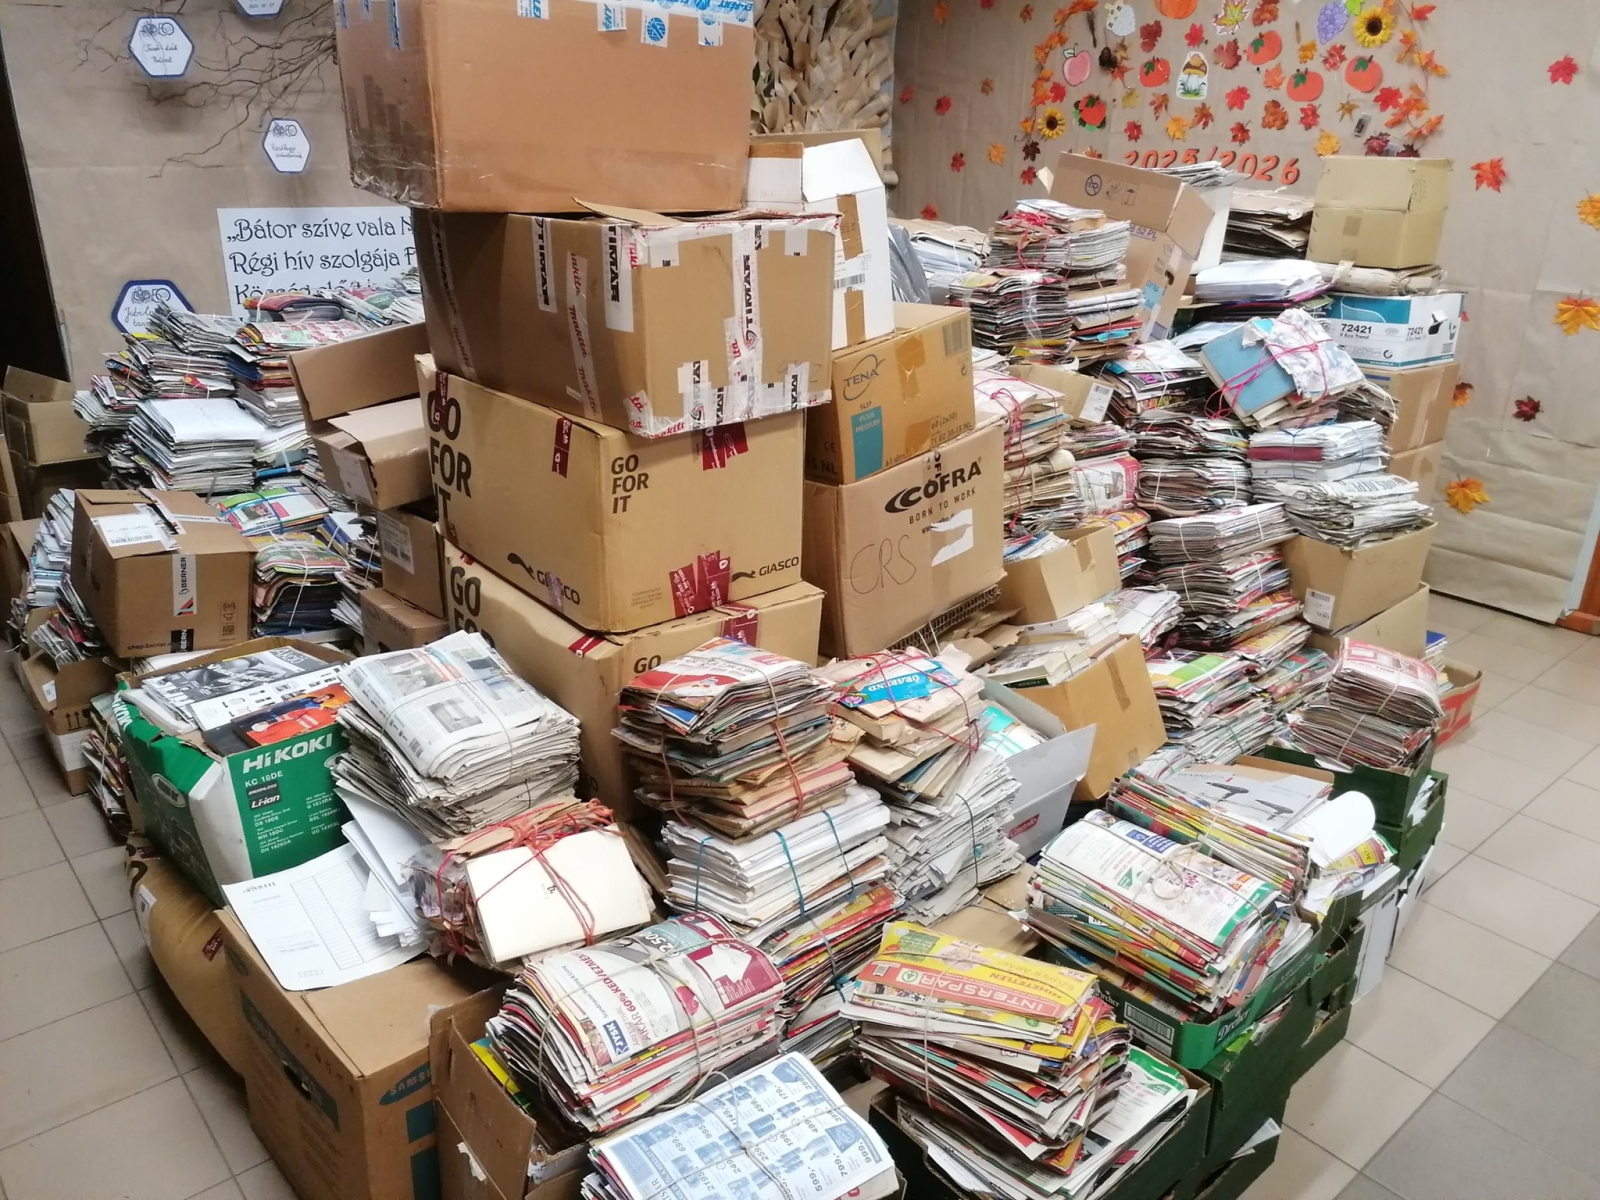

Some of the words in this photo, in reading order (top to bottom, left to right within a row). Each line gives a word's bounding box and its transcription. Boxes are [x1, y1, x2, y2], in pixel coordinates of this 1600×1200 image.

[301, 218, 353, 239] szíve
[356, 217, 396, 236] vala
[229, 251, 279, 277] Régi
[284, 251, 314, 271] hív
[320, 248, 400, 273] szolgája
[1341, 323, 1373, 334] 72421
[1407, 326, 1424, 336] 72421
[843, 368, 879, 388] TENA
[430, 437, 472, 498] FOR
[611, 454, 639, 476] GO
[612, 472, 650, 495] FOR
[885, 461, 982, 514] COFRA
[612, 495, 631, 514] IT
[909, 507, 933, 524] BORN
[939, 501, 949, 511] TO
[954, 487, 976, 503] WORK
[759, 556, 800, 577] GIASCO
[450, 566, 481, 618] GO
[634, 654, 662, 674] GO
[243, 733, 333, 775] HiKOKI
[245, 779, 258, 788] KC
[921, 973, 1044, 1012] INTERSPAR
[606, 1022, 624, 1047] JYSK
